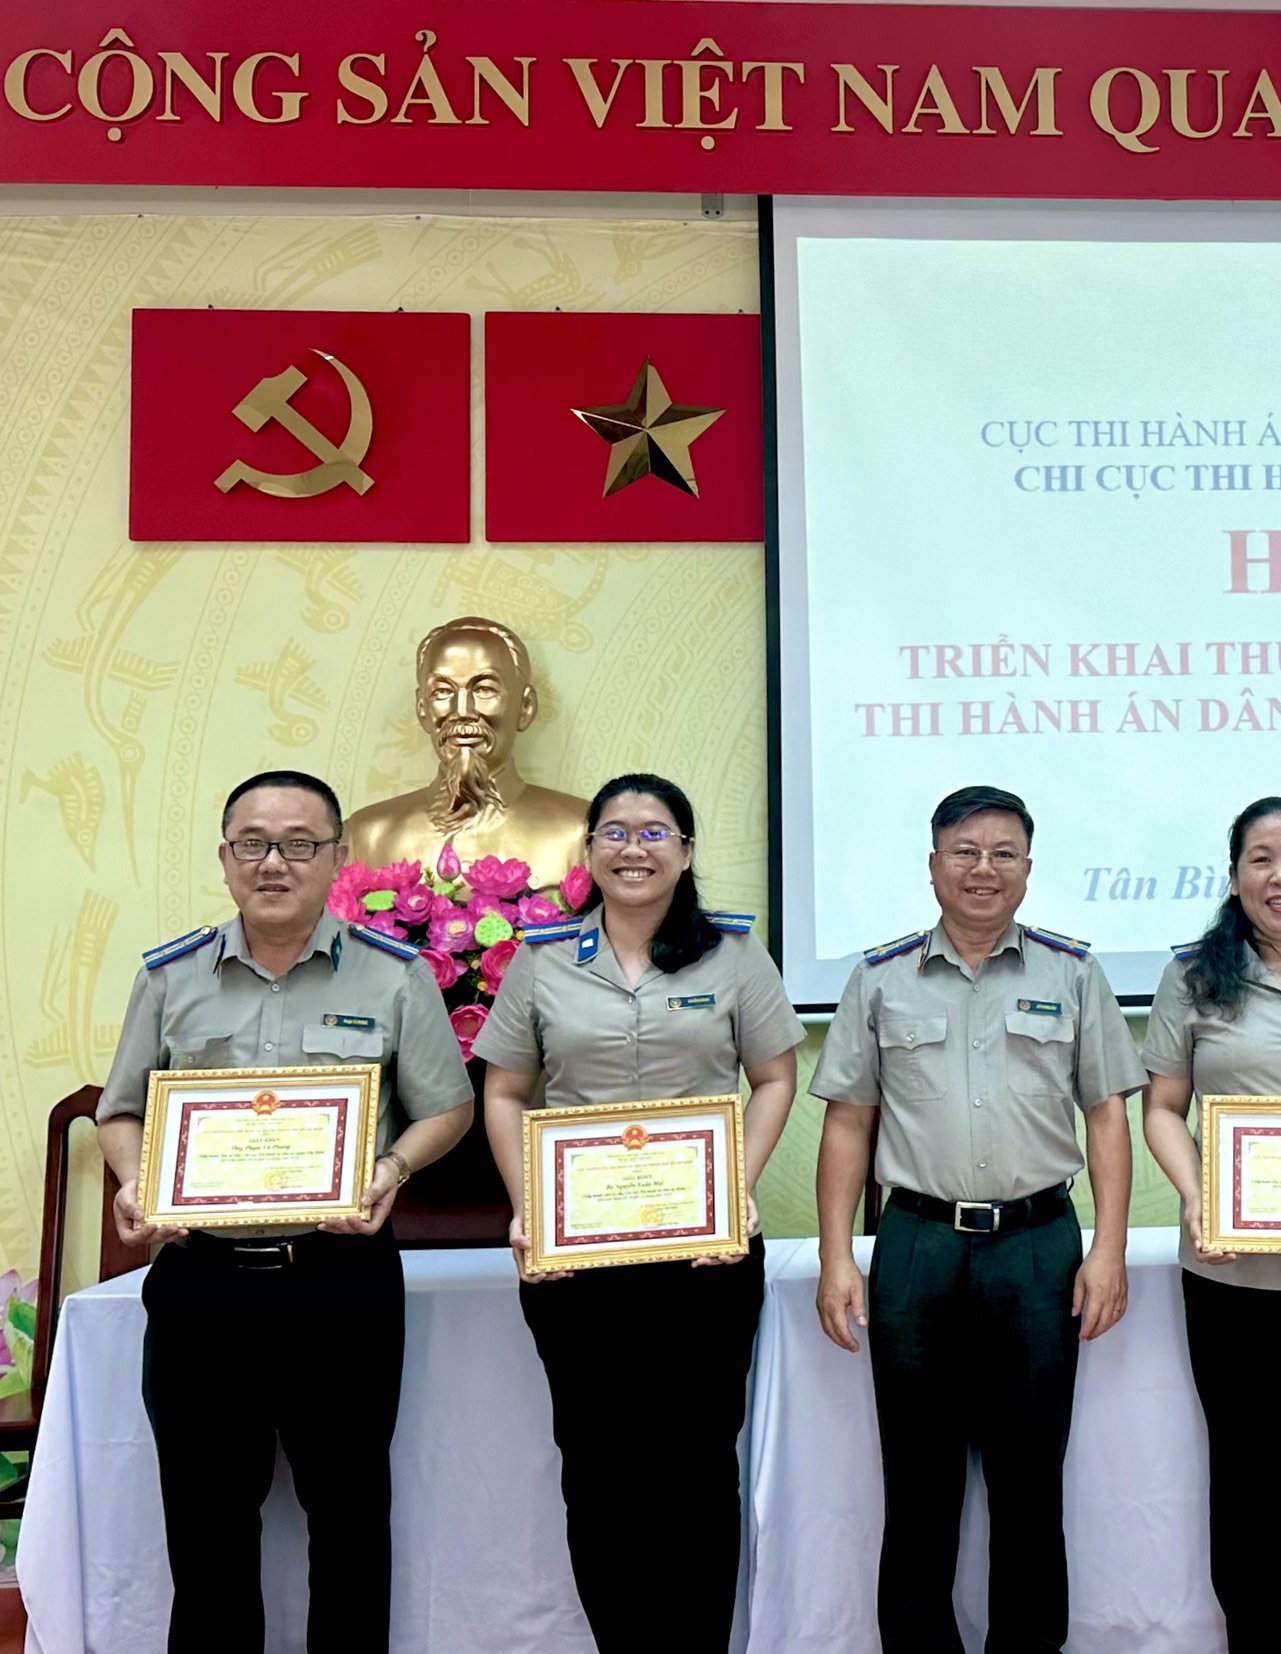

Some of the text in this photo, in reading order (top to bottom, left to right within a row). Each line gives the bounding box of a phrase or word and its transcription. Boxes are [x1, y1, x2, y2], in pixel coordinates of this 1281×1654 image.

[5, 29, 308, 142] CỘNG
[337, 30, 537, 127] SẢN
[562, 39, 805, 151] VIỆT
[831, 64, 1064, 136] NAM
[980, 420, 1058, 454] CỤC
[1068, 420, 1130, 448] THI
[1139, 412, 1247, 448] HÀNH
[1014, 465, 1086, 493] CHI
[1095, 463, 1176, 500] CỤC
[1184, 464, 1253, 491] THI
[899, 634, 1052, 680] TRIỂN
[1066, 642, 1193, 677] KHAI
[854, 702, 944, 737] THI
[957, 692, 1101, 735] HÀNH
[1115, 692, 1182, 733] ÁN
[1082, 866, 1159, 902] Tân
[1170, 865, 1231, 901] Bì
